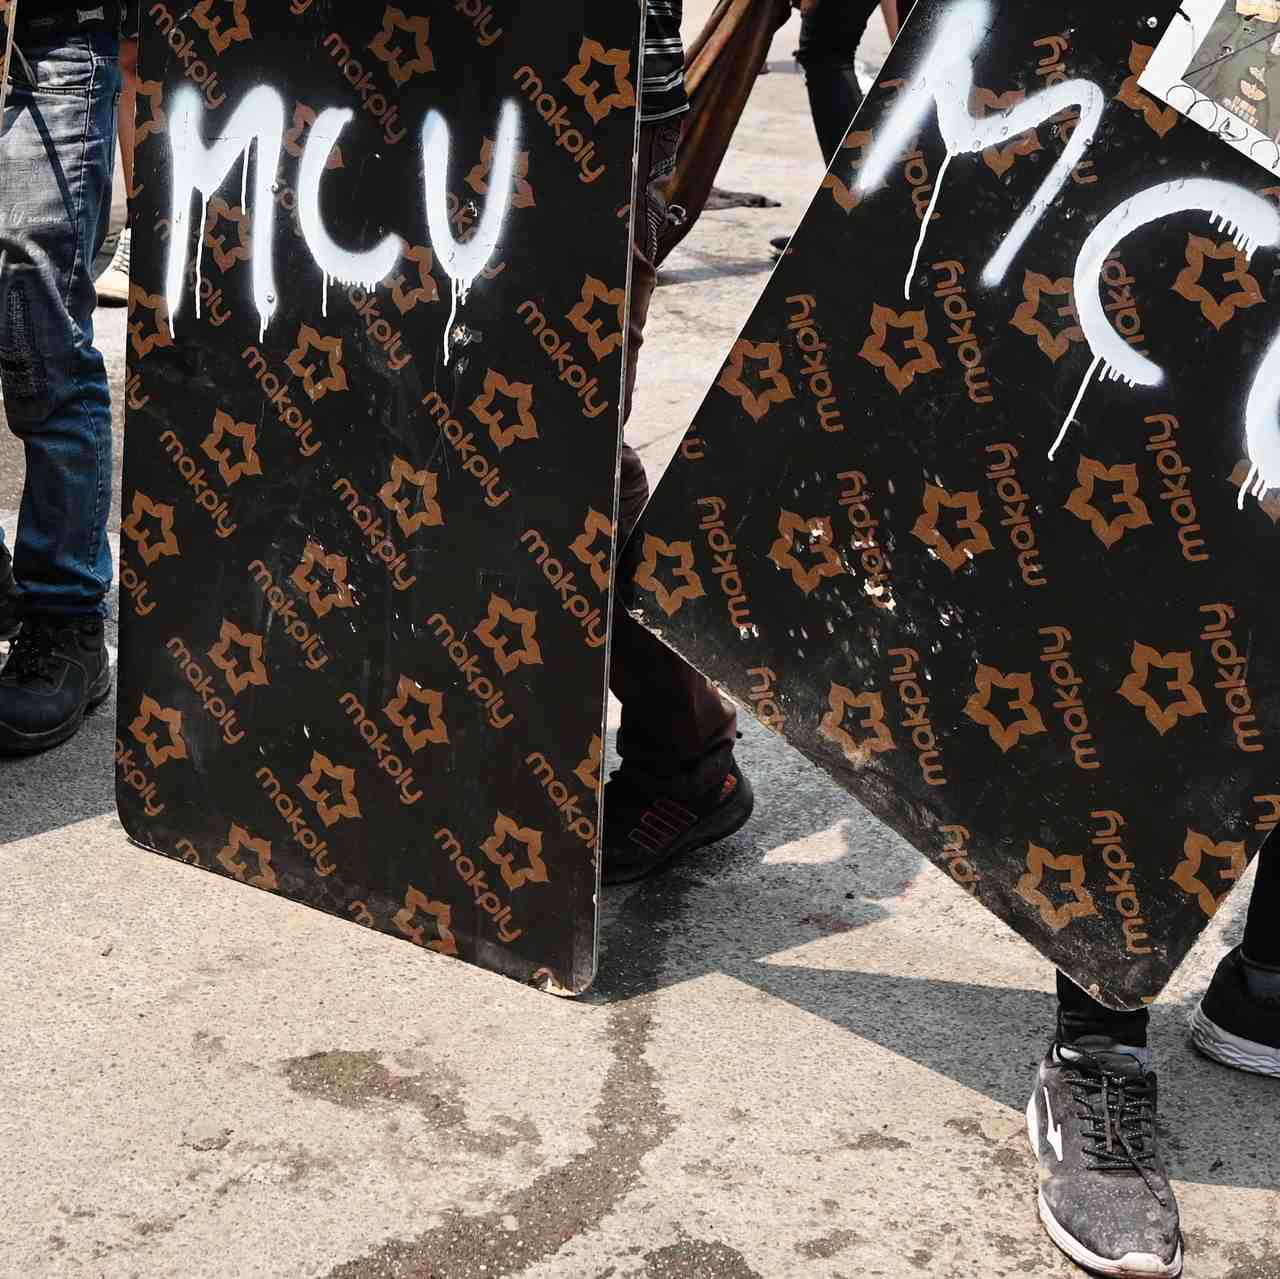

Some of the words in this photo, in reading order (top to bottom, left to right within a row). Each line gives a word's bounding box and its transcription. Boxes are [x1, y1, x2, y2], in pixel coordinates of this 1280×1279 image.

[149, 2, 227, 109] makply
[323, 32, 407, 144] makply
[514, 65, 605, 185] makply
[167, 83, 520, 338] MCU
[517, 299, 609, 418] makply
[786, 293, 844, 432] makply
[933, 260, 994, 405] makply
[242, 345, 322, 457] makply
[421, 391, 512, 508] makply
[160, 430, 237, 538] makply
[332, 477, 417, 592] makply
[986, 443, 1048, 588] makply
[1146, 412, 1209, 563] makply
[120, 560, 157, 616] ply
[248, 559, 328, 671] makply
[521, 529, 608, 648] makply
[166, 637, 245, 744] makply
[427, 612, 514, 729] makply
[747, 666, 785, 734] ply
[889, 648, 946, 787] makply
[1039, 626, 1100, 770] makply
[1200, 603, 1264, 753] makply
[339, 692, 422, 805] makply
[525, 751, 597, 855] makp
[256, 767, 336, 877] makply
[939, 823, 978, 895] ply
[433, 827, 522, 943] makply
[1091, 810, 1152, 955] makply
